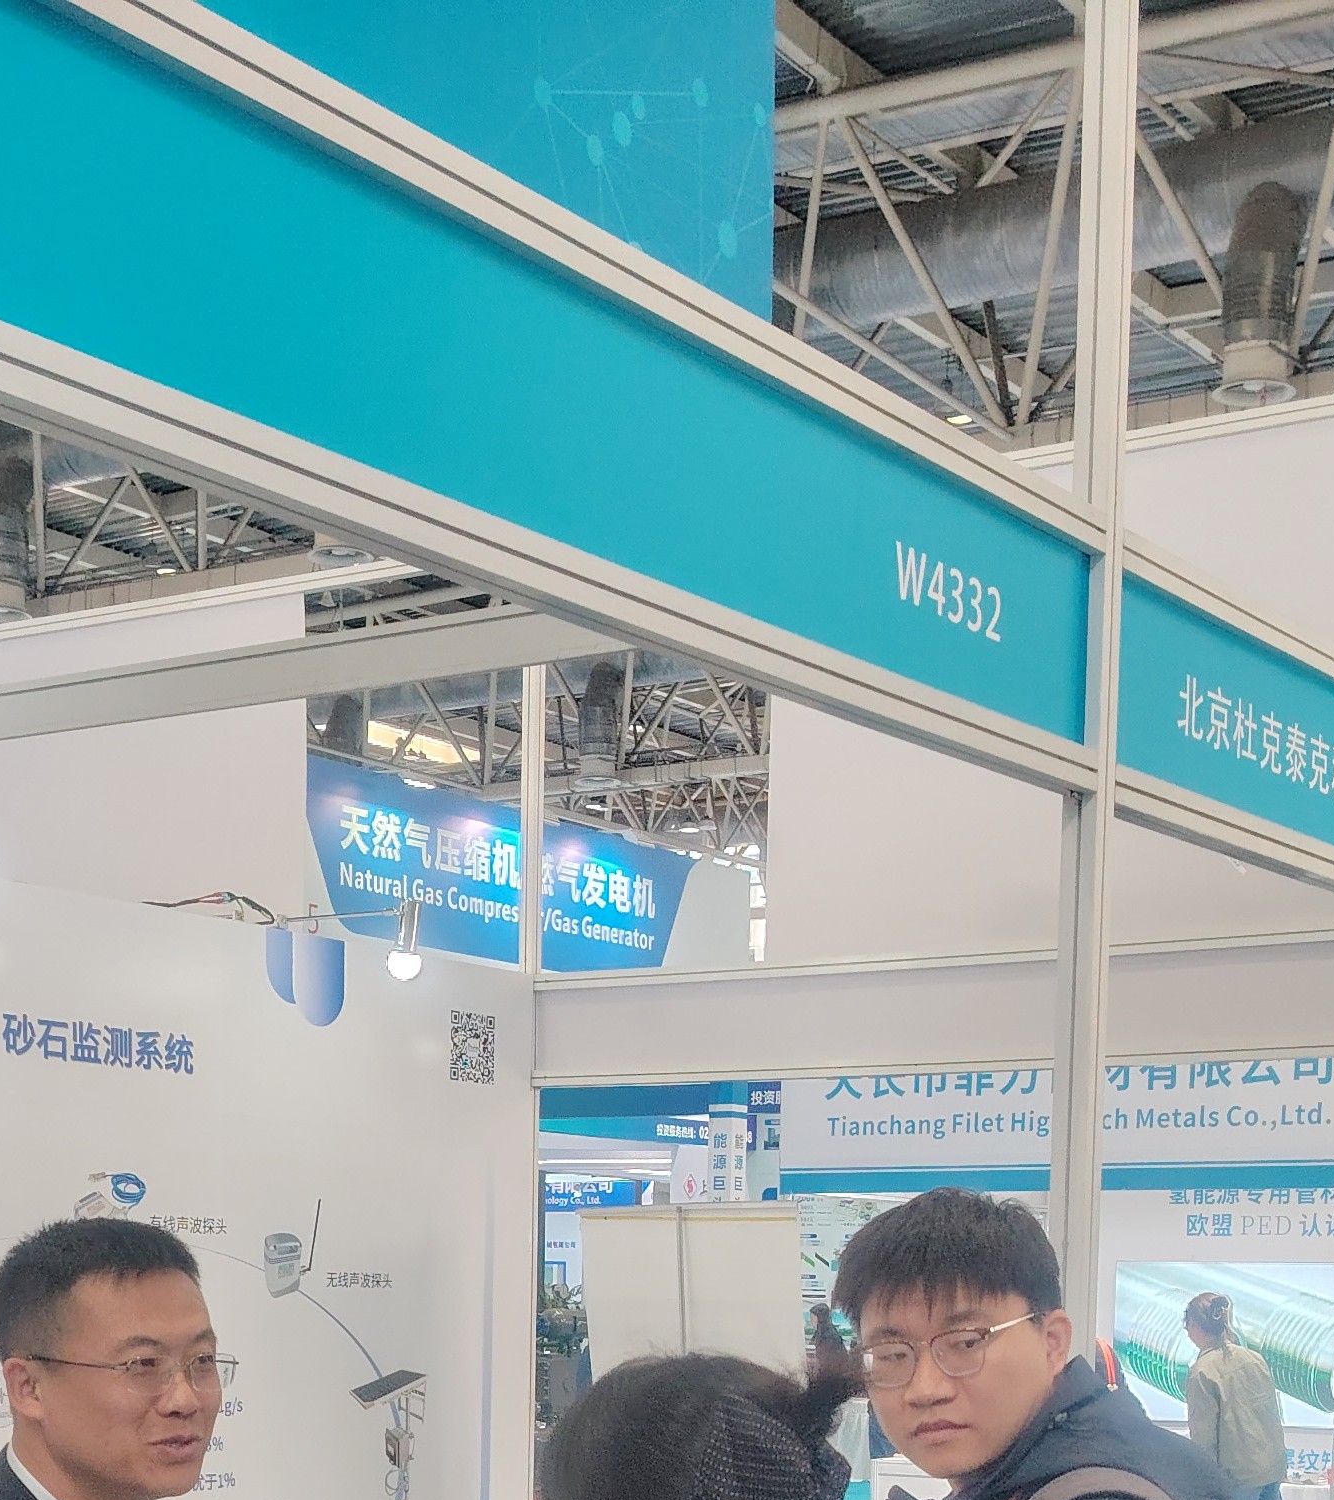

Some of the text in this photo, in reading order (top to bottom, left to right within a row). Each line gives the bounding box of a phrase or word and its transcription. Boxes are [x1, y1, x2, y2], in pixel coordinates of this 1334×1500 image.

[895, 540, 1002, 643] W4332
[340, 861, 408, 899] Natural
[412, 879, 443, 908] Gas
[581, 916, 655, 950] Generator
[2, 1012, 195, 1076] 砂石监测系统
[827, 1115, 946, 1139] Tianchang
[952, 1112, 1004, 1133] Filet
[1136, 1105, 1219, 1128] Metals
[1186, 1213, 1233, 1237] 欧盟
[1240, 1215, 1292, 1236] PED
[325, 1271, 393, 1290] 无线声波探头
